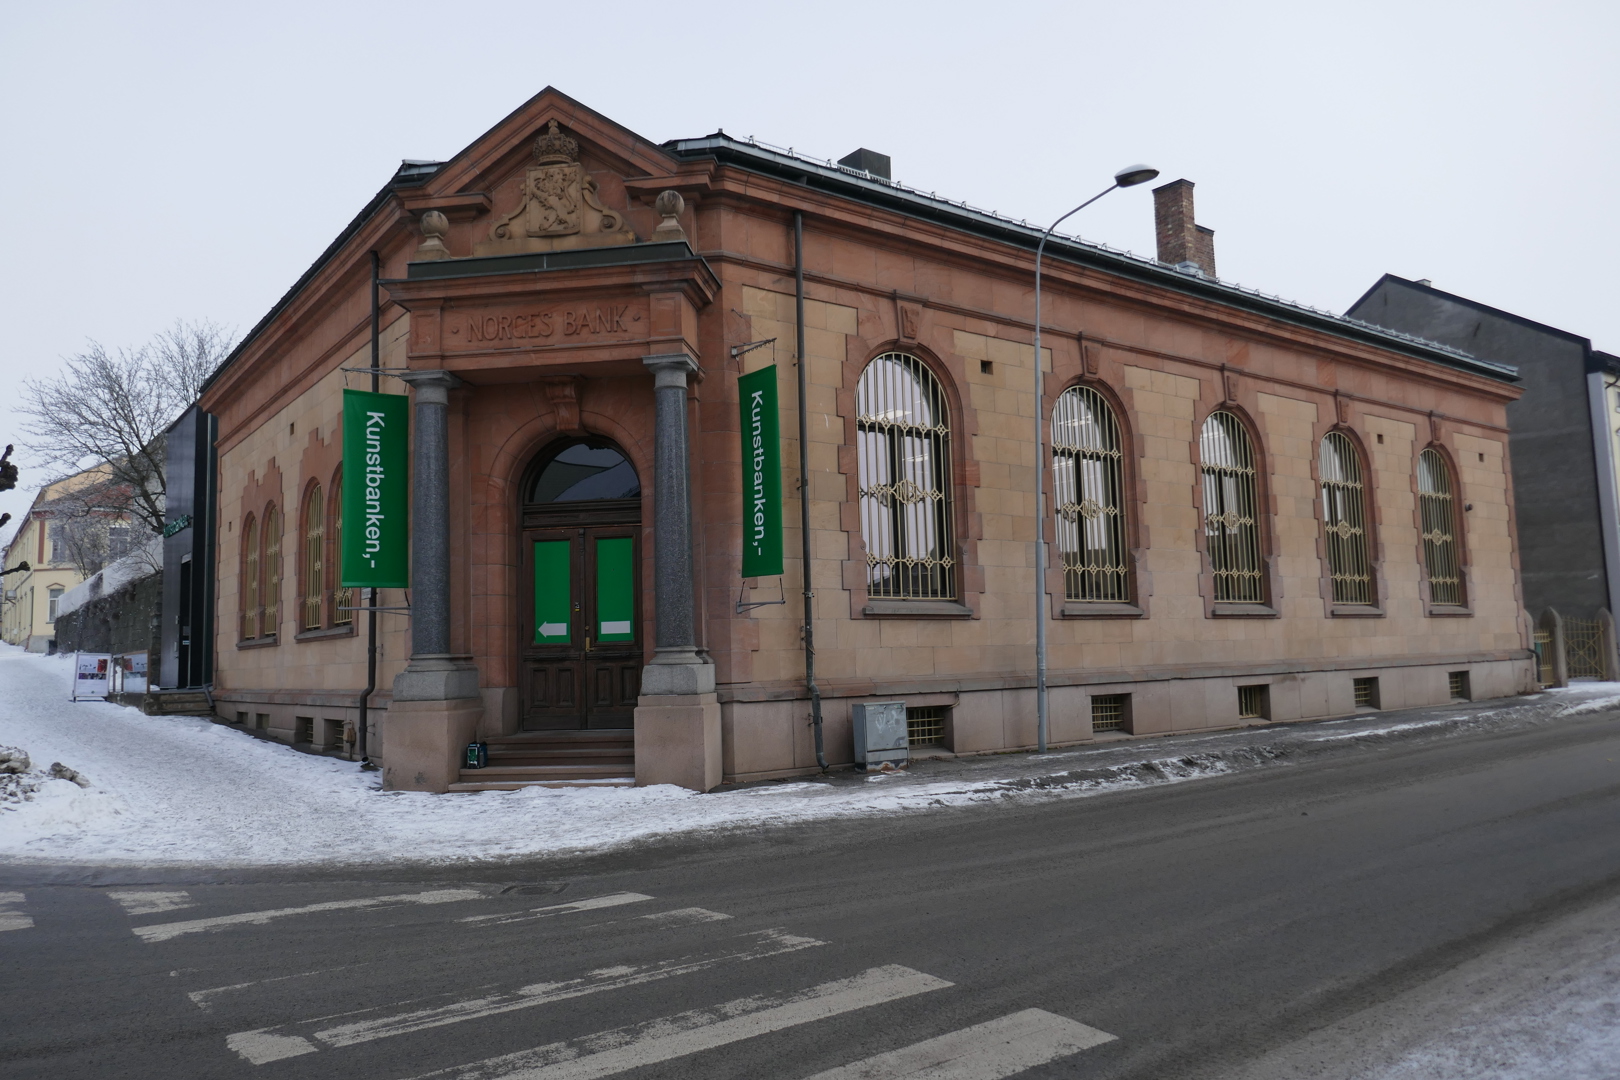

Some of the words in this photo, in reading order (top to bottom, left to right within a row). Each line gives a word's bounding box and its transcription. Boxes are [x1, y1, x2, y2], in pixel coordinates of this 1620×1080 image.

[467, 313, 554, 342] NORGES
[563, 305, 628, 336] BANK
[362, 411, 386, 568] Kunstbanken,-
[751, 390, 767, 556] Kunstbanken,-
